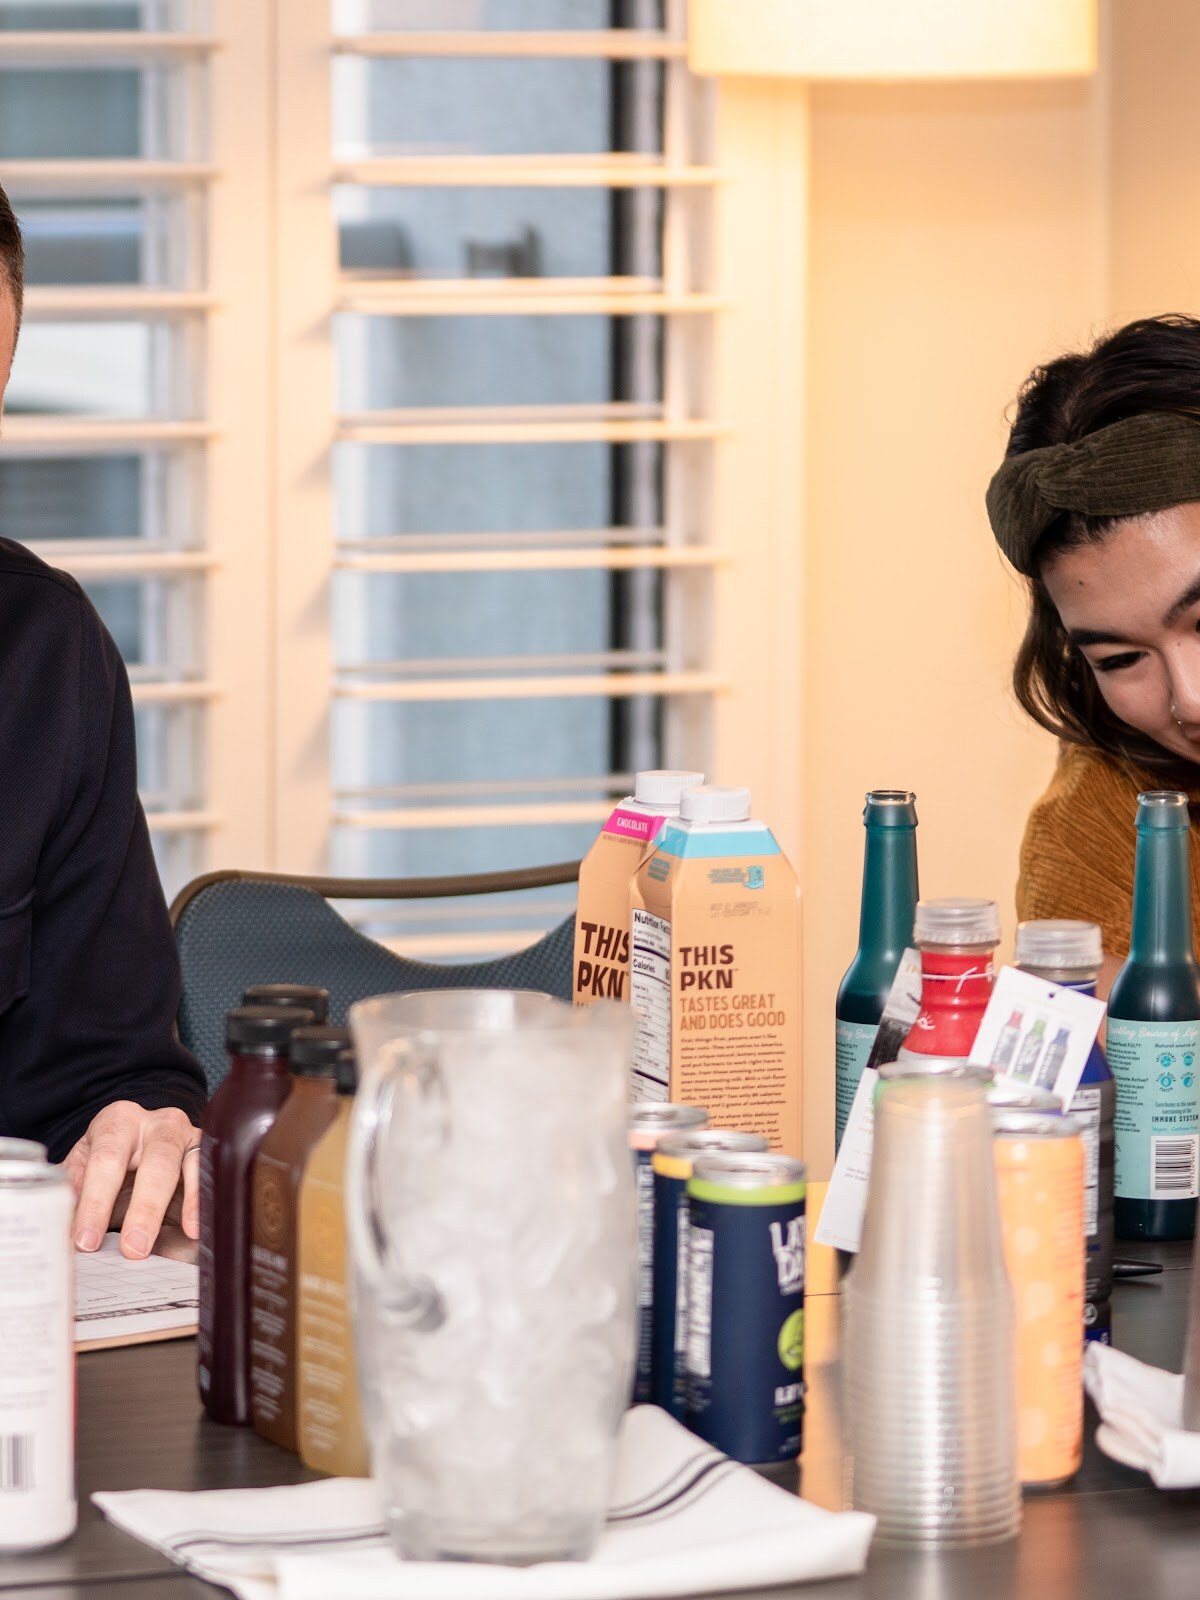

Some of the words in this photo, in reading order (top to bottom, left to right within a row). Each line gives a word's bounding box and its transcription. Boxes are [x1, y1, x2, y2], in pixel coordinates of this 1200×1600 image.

[617, 816, 648, 833] CHOCOLATE
[581, 922, 629, 964] THIS
[679, 944, 734, 966] THIS
[680, 995, 728, 1012] TASTES
[732, 994, 775, 1010] GREAT
[680, 1015, 706, 1030] AND
[710, 1012, 743, 1029] DOES
[747, 1011, 785, 1027] GOOD
